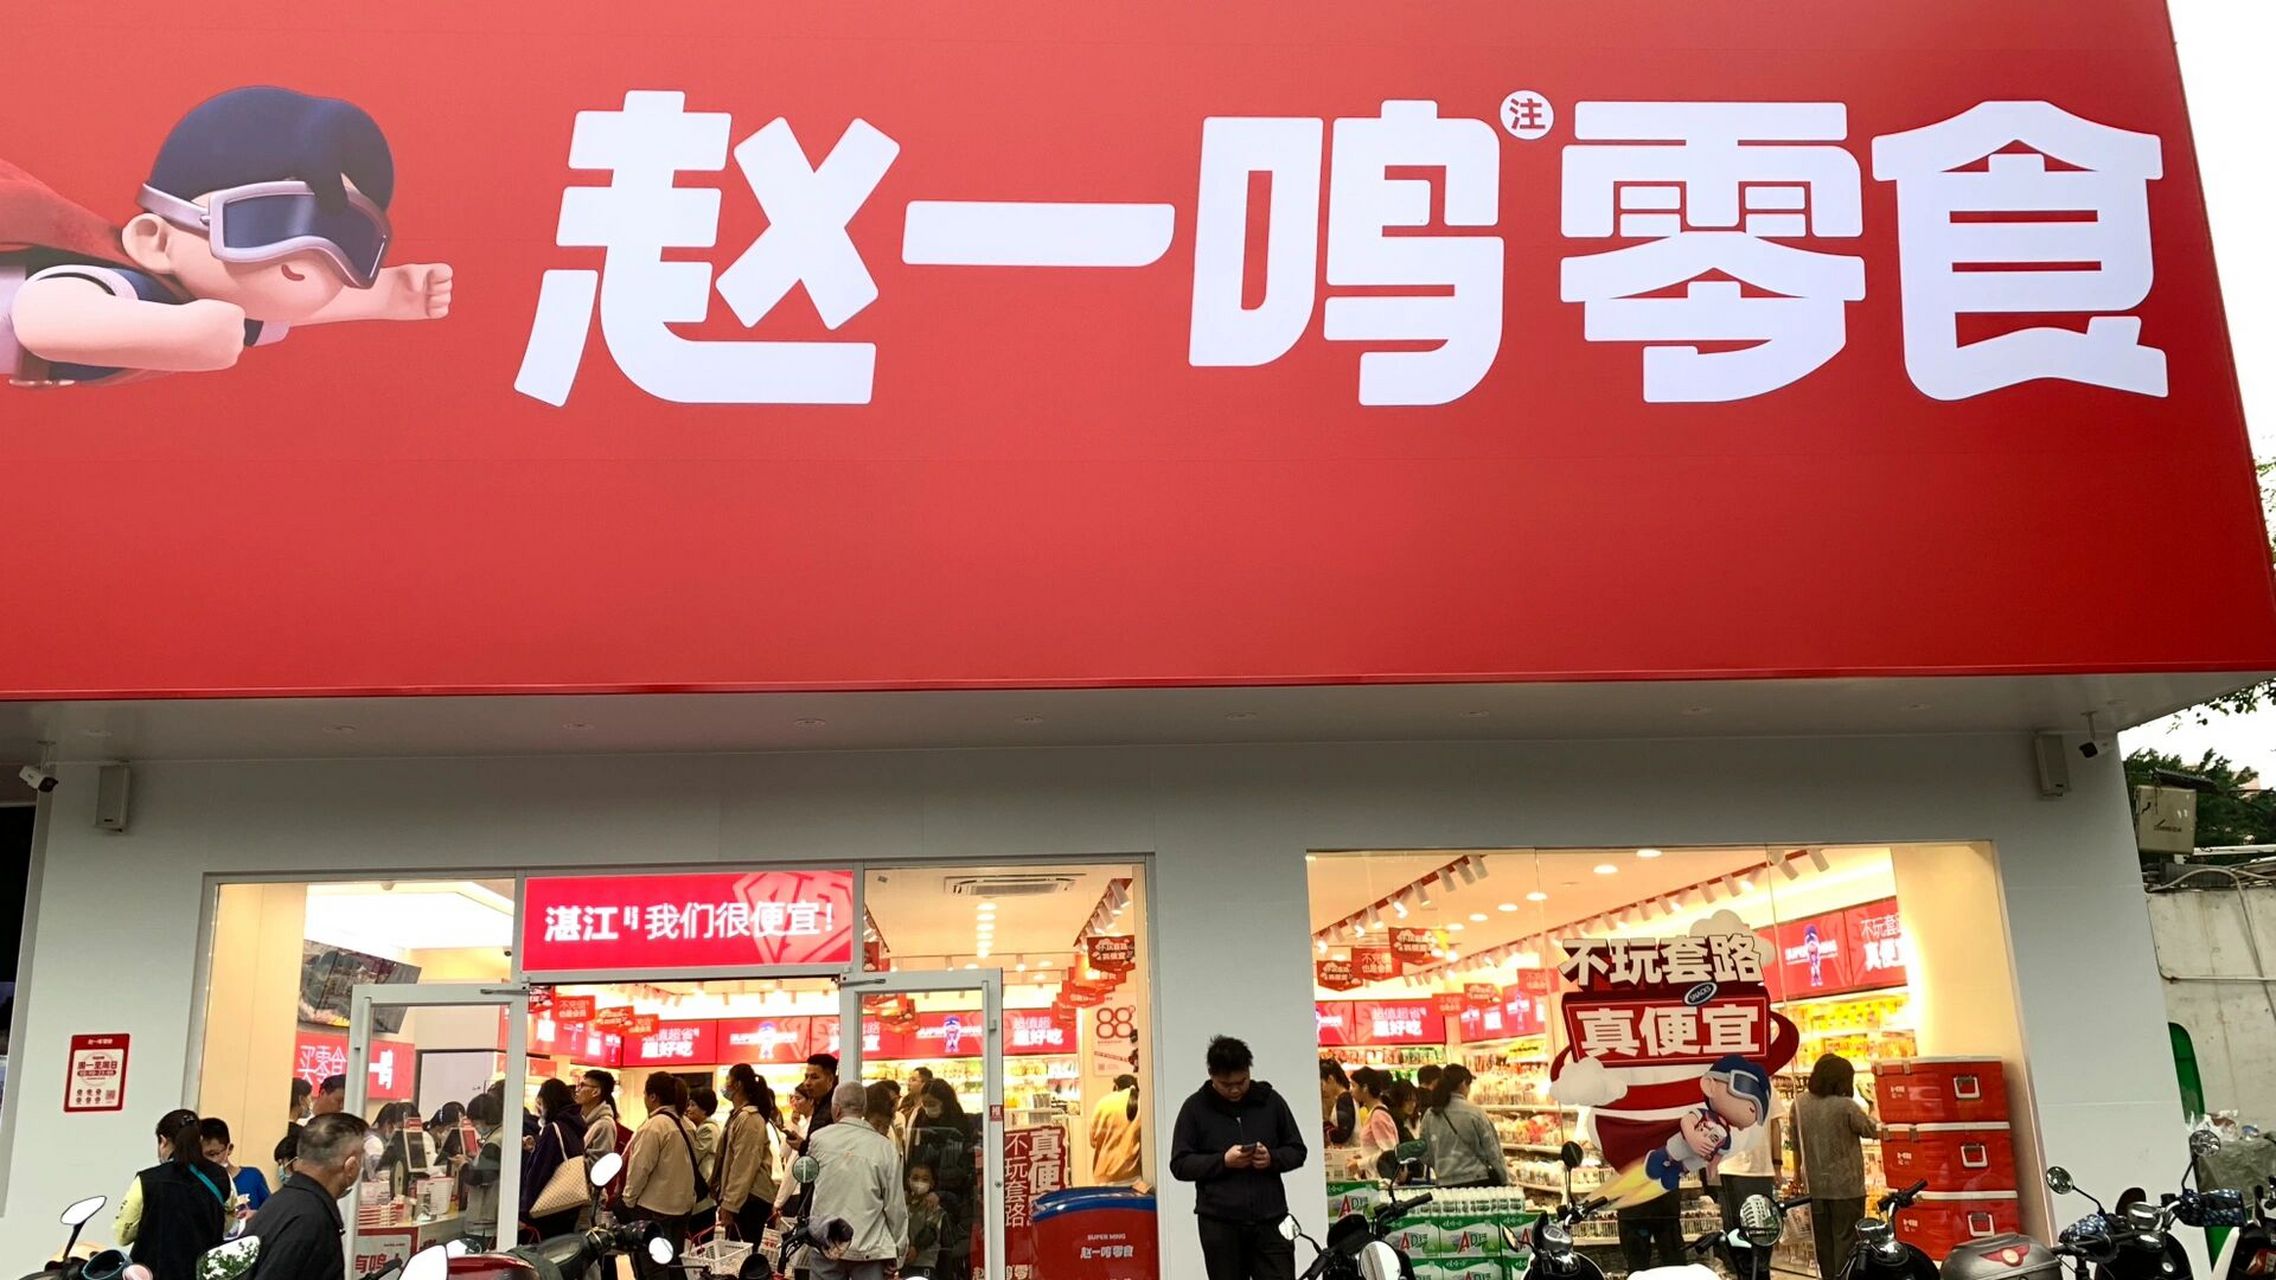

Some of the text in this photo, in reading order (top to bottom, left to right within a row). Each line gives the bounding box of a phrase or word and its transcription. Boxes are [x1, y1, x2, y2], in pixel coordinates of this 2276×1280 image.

[1508, 97, 1546, 133] 注
[513, 89, 2169, 407] 赵一鸣零食
[1557, 933, 1765, 986] 不玩套路
[1576, 1004, 1760, 1058] 真便宜
[1004, 1131, 1029, 1228] 不玩套路
[1028, 1128, 1062, 1198] 真便
